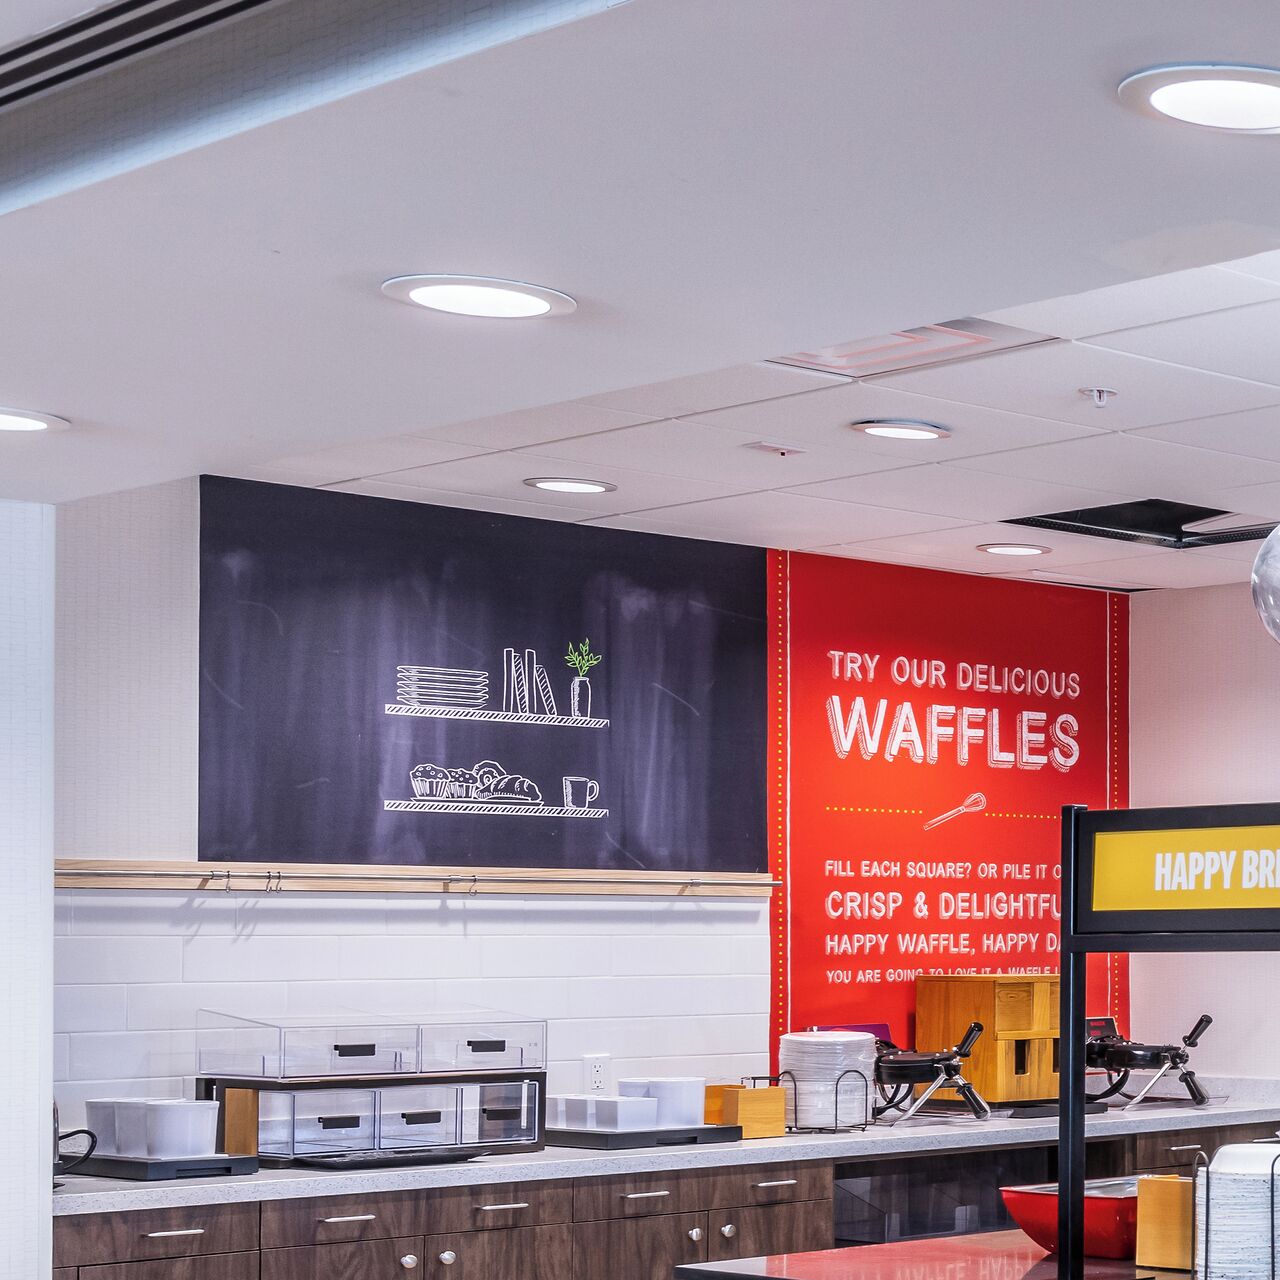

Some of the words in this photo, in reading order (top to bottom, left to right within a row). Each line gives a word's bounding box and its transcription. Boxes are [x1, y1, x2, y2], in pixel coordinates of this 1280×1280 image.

[827, 650, 880, 682] TRY
[891, 656, 946, 688] OUR
[957, 662, 1080, 700] DELICIOUS
[826, 695, 1080, 773] WAFFLES
[825, 860, 854, 877] FILL
[860, 860, 900, 877] EACH
[906, 861, 972, 879] SQUARE?
[978, 863, 997, 879] OR
[1003, 864, 1031, 880] PILE
[1036, 864, 1047, 880] IT
[1155, 850, 1237, 890] HAPPY
[825, 890, 902, 919] CRISP
[913, 891, 929, 919] &
[939, 892, 1062, 920] DELIGHTFU
[825, 934, 888, 955] HAPPY
[897, 933, 976, 955] WAFFLE,
[982, 933, 1039, 953] HAPPY
[826, 970, 851, 984] YOU
[856, 969, 881, 983] ARE
